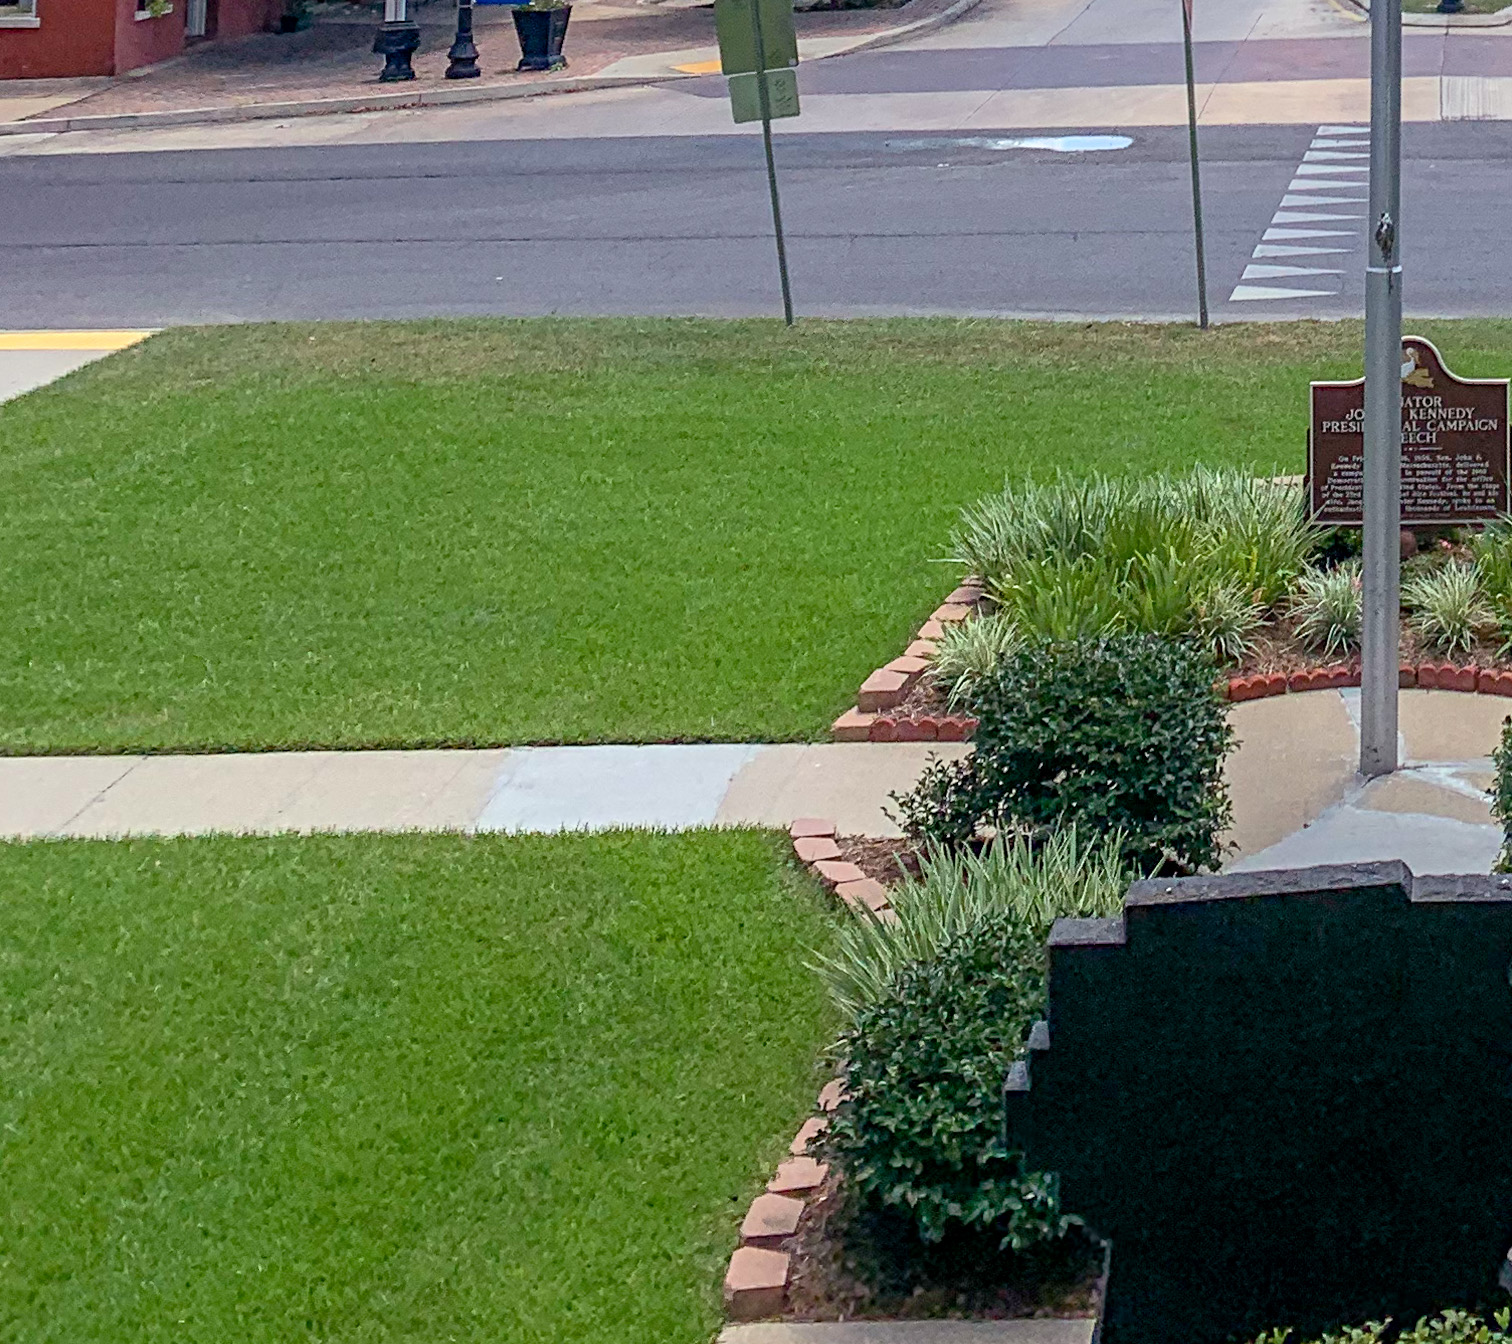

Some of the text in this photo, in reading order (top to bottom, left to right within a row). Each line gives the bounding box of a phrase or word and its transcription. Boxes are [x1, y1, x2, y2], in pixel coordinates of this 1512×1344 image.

[1400, 395, 1442, 408] ATOR
[1345, 407, 1476, 421] JO KENNEDY
[1426, 418, 1499, 431] CAMPAIGN
[1400, 431, 1437, 444] EECH
